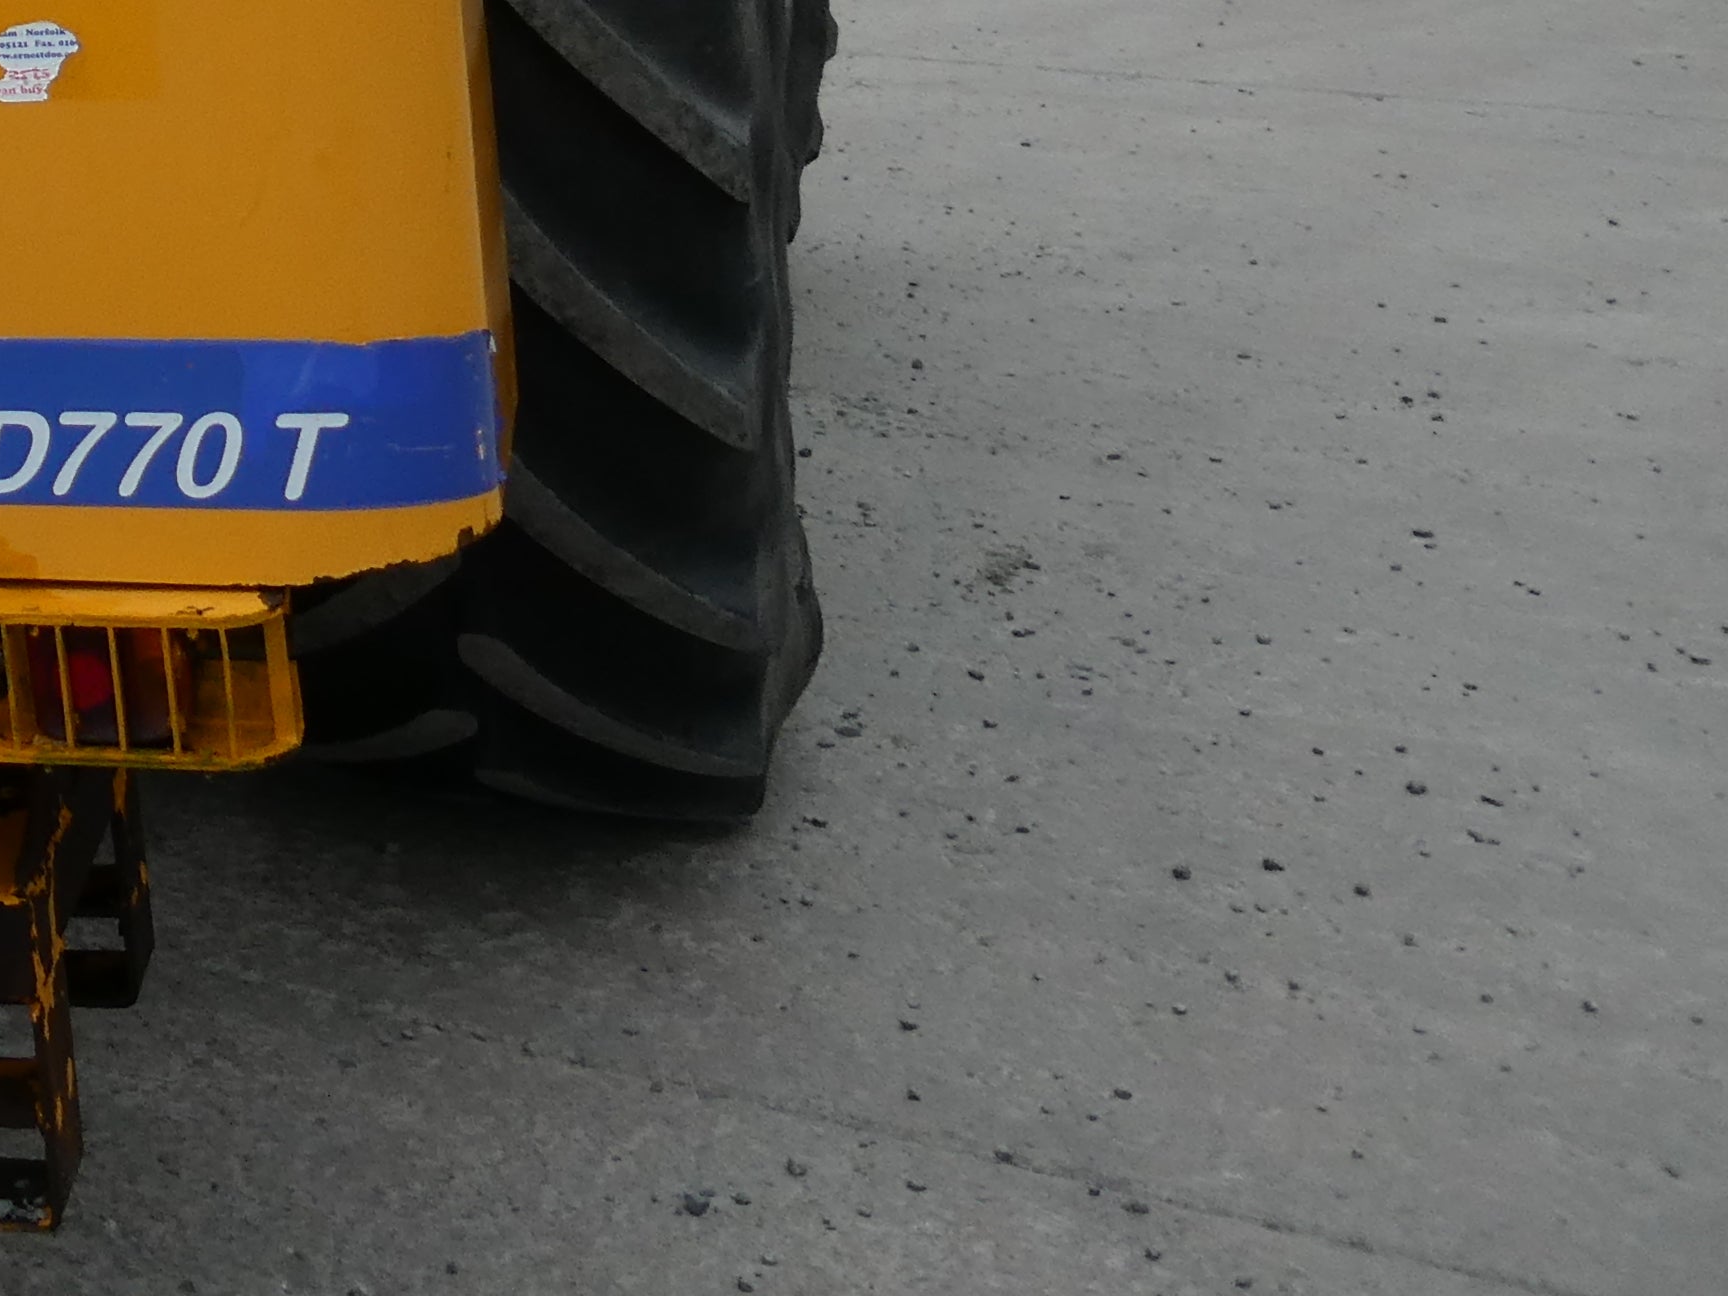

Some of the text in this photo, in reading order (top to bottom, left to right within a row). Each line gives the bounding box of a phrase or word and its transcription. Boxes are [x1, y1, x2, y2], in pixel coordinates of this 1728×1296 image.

[26, 28, 66, 36] Norfolk
[21, 86, 42, 95] buy
[275, 412, 350, 501] T
